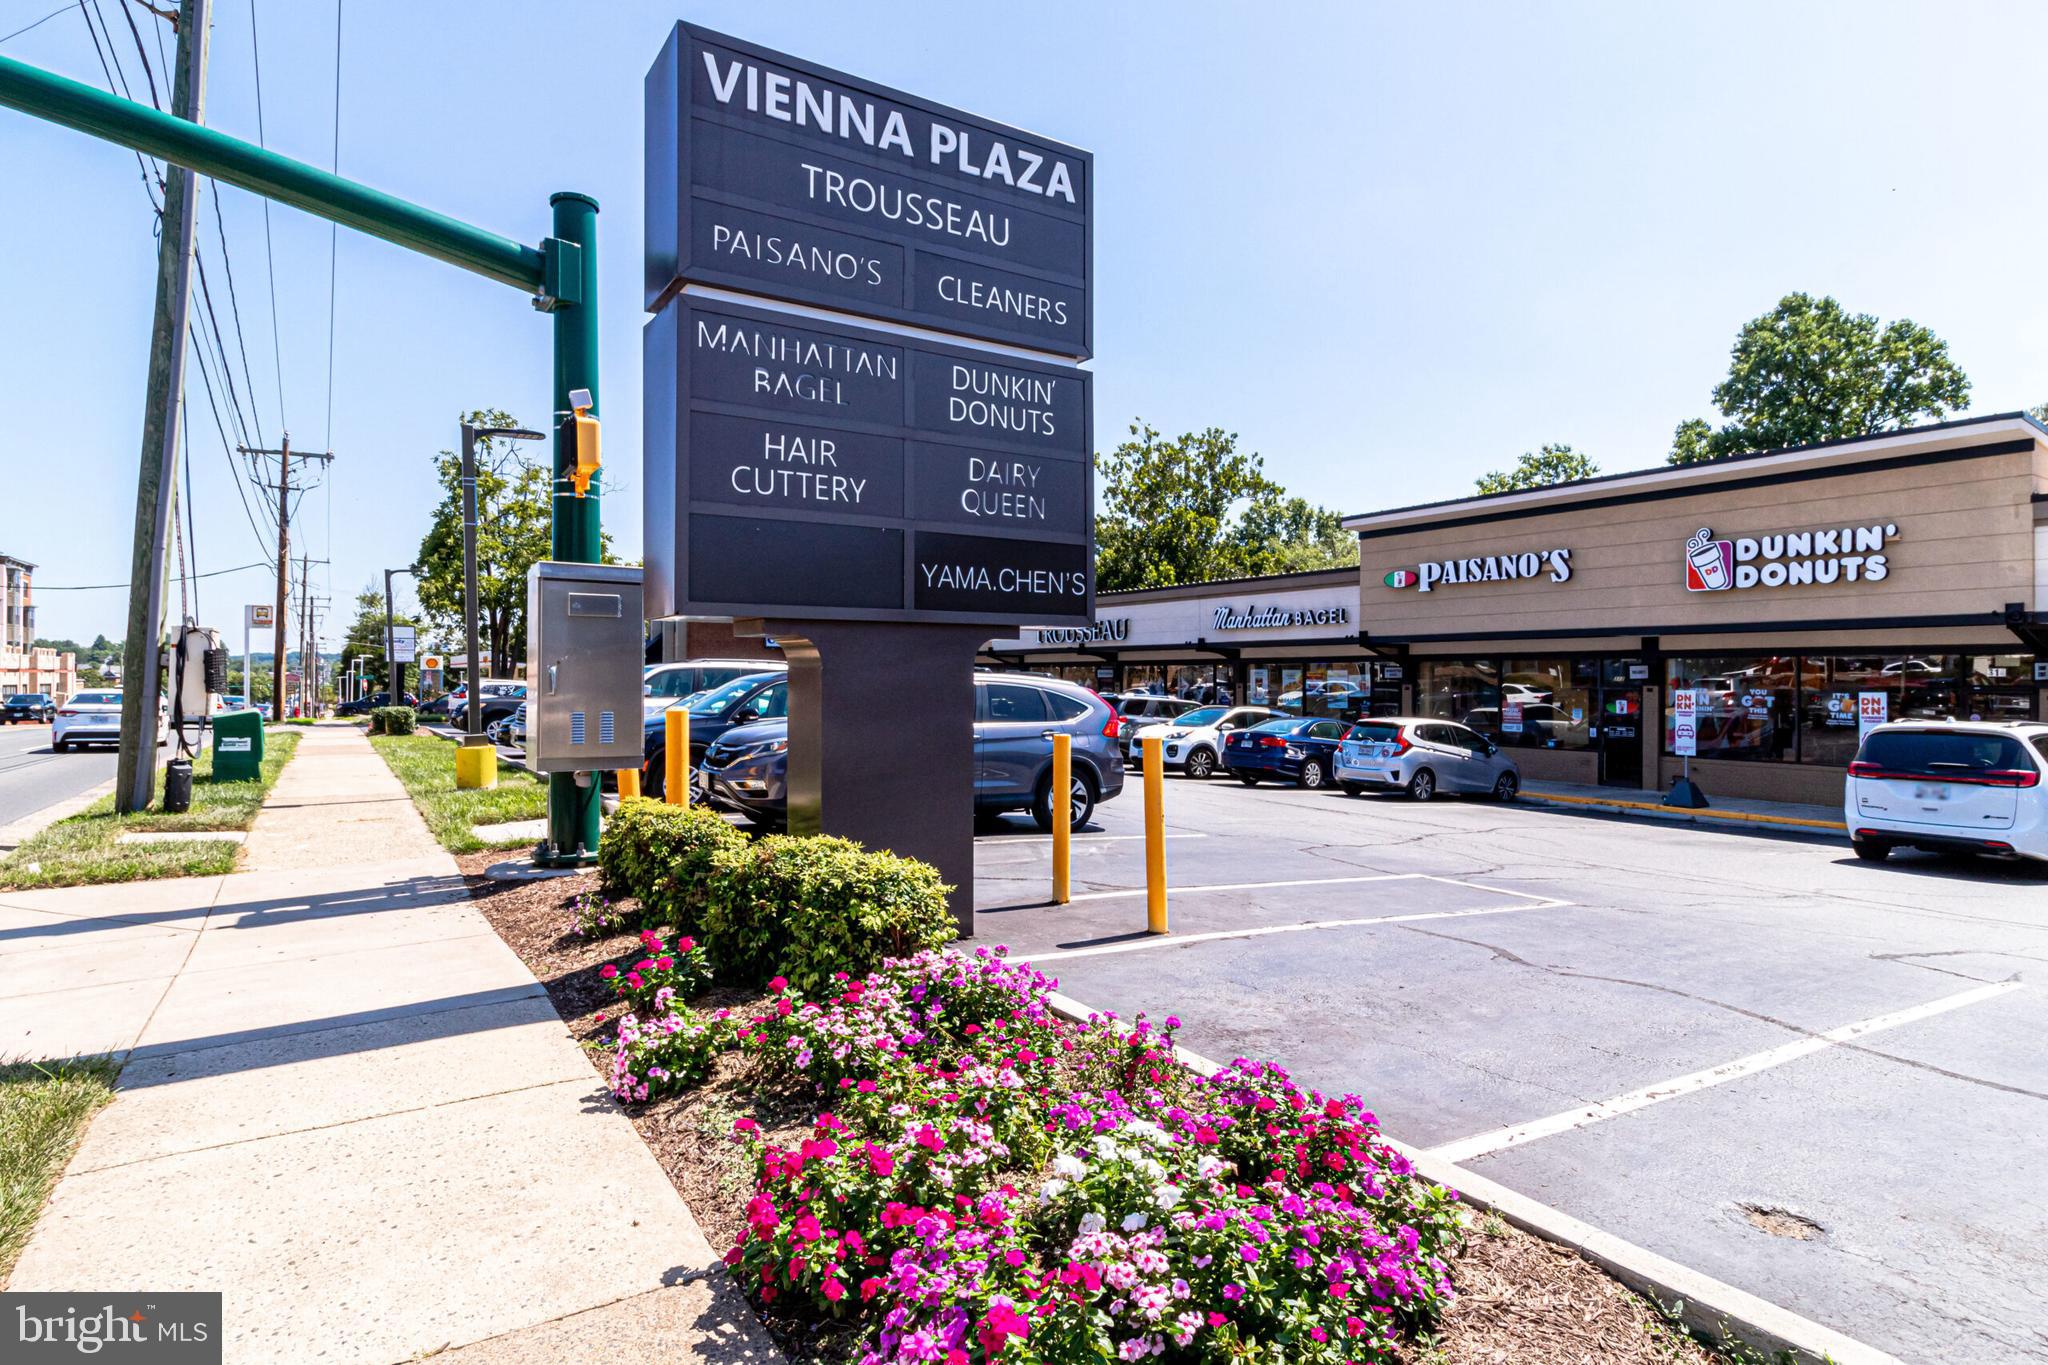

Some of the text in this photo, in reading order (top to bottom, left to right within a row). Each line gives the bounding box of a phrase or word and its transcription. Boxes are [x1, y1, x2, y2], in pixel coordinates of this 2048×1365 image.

[703, 51, 1076, 203] VIENNA PLAZA
[801, 163, 1010, 246] TROUSSEAU
[713, 224, 882, 285] PAISANO'S
[937, 275, 1068, 325] CLEANERS
[698, 321, 897, 379] MANHATTAN
[754, 367, 850, 406] BAGEL
[952, 365, 1056, 405] DUNKIN'
[949, 397, 1055, 436] DONUTS
[764, 433, 837, 467] HAIR
[731, 466, 867, 503] CUTTERY
[969, 458, 1041, 489] DAIRY
[961, 488, 1046, 521] QUEEN
[1736, 524, 1897, 562] DUNKIN'
[921, 563, 1086, 596] YAMA.CHEN'S
[1418, 548, 1572, 592] PAISANO'S
[1705, 565, 1719, 576] DD
[1735, 555, 1888, 589] DONUTS
[1213, 605, 1348, 630] Manhattan BAGEL
[1677, 694, 1692, 702] DN
[1861, 697, 1881, 706] DN
